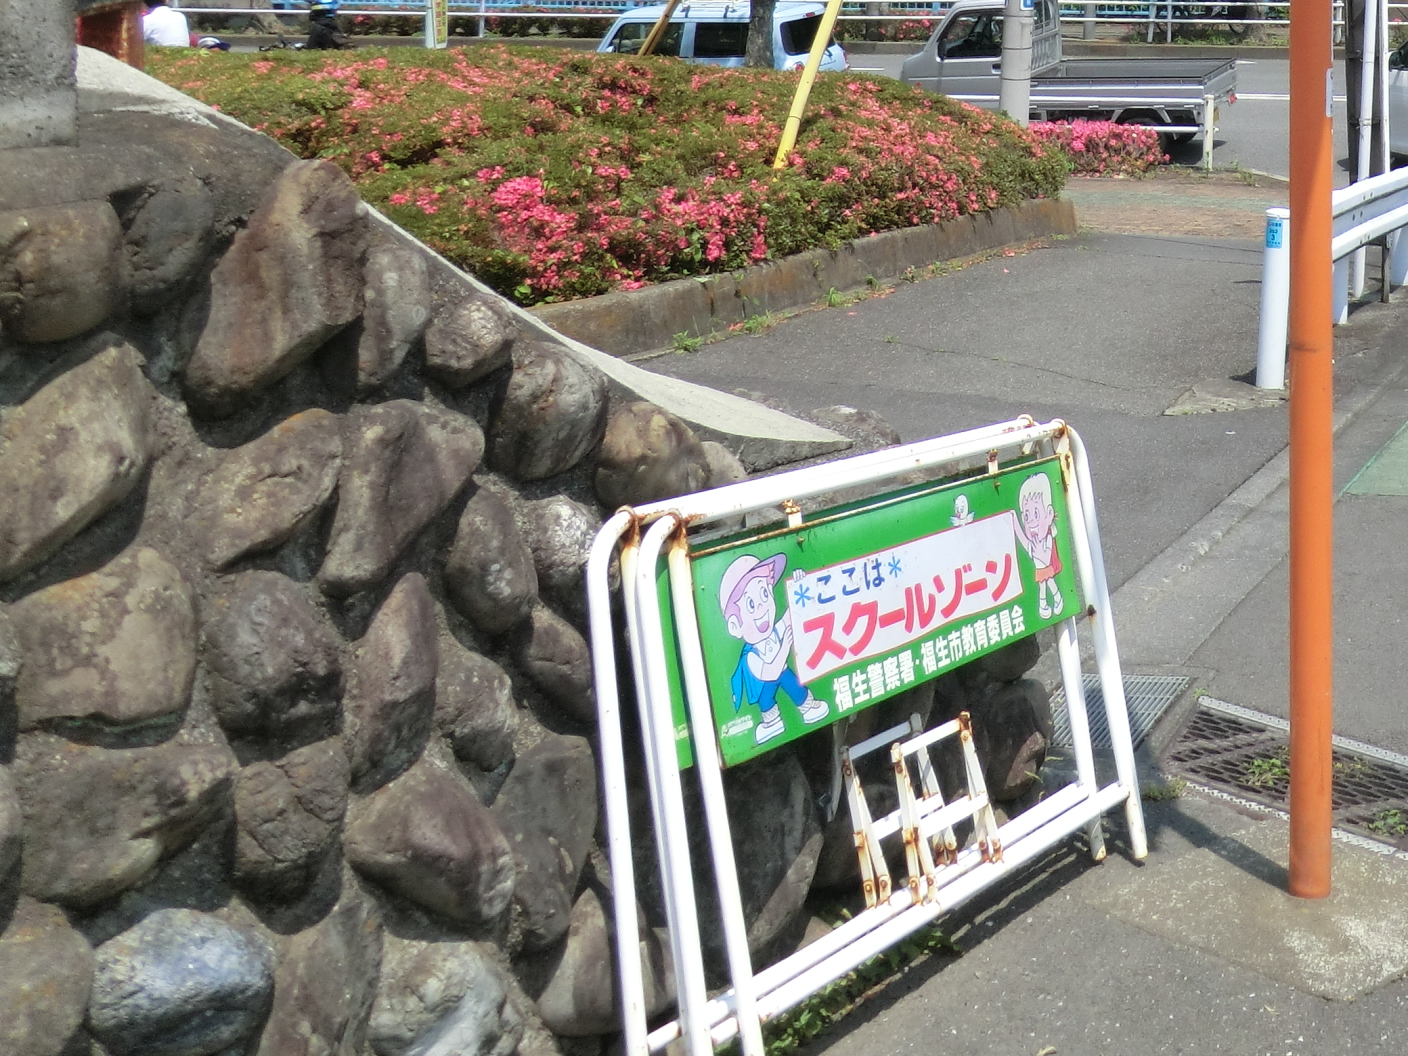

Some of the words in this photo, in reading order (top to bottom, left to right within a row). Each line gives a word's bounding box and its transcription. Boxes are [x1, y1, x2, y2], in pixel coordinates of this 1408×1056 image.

[802, 553, 1012, 670] スクールゾーン
